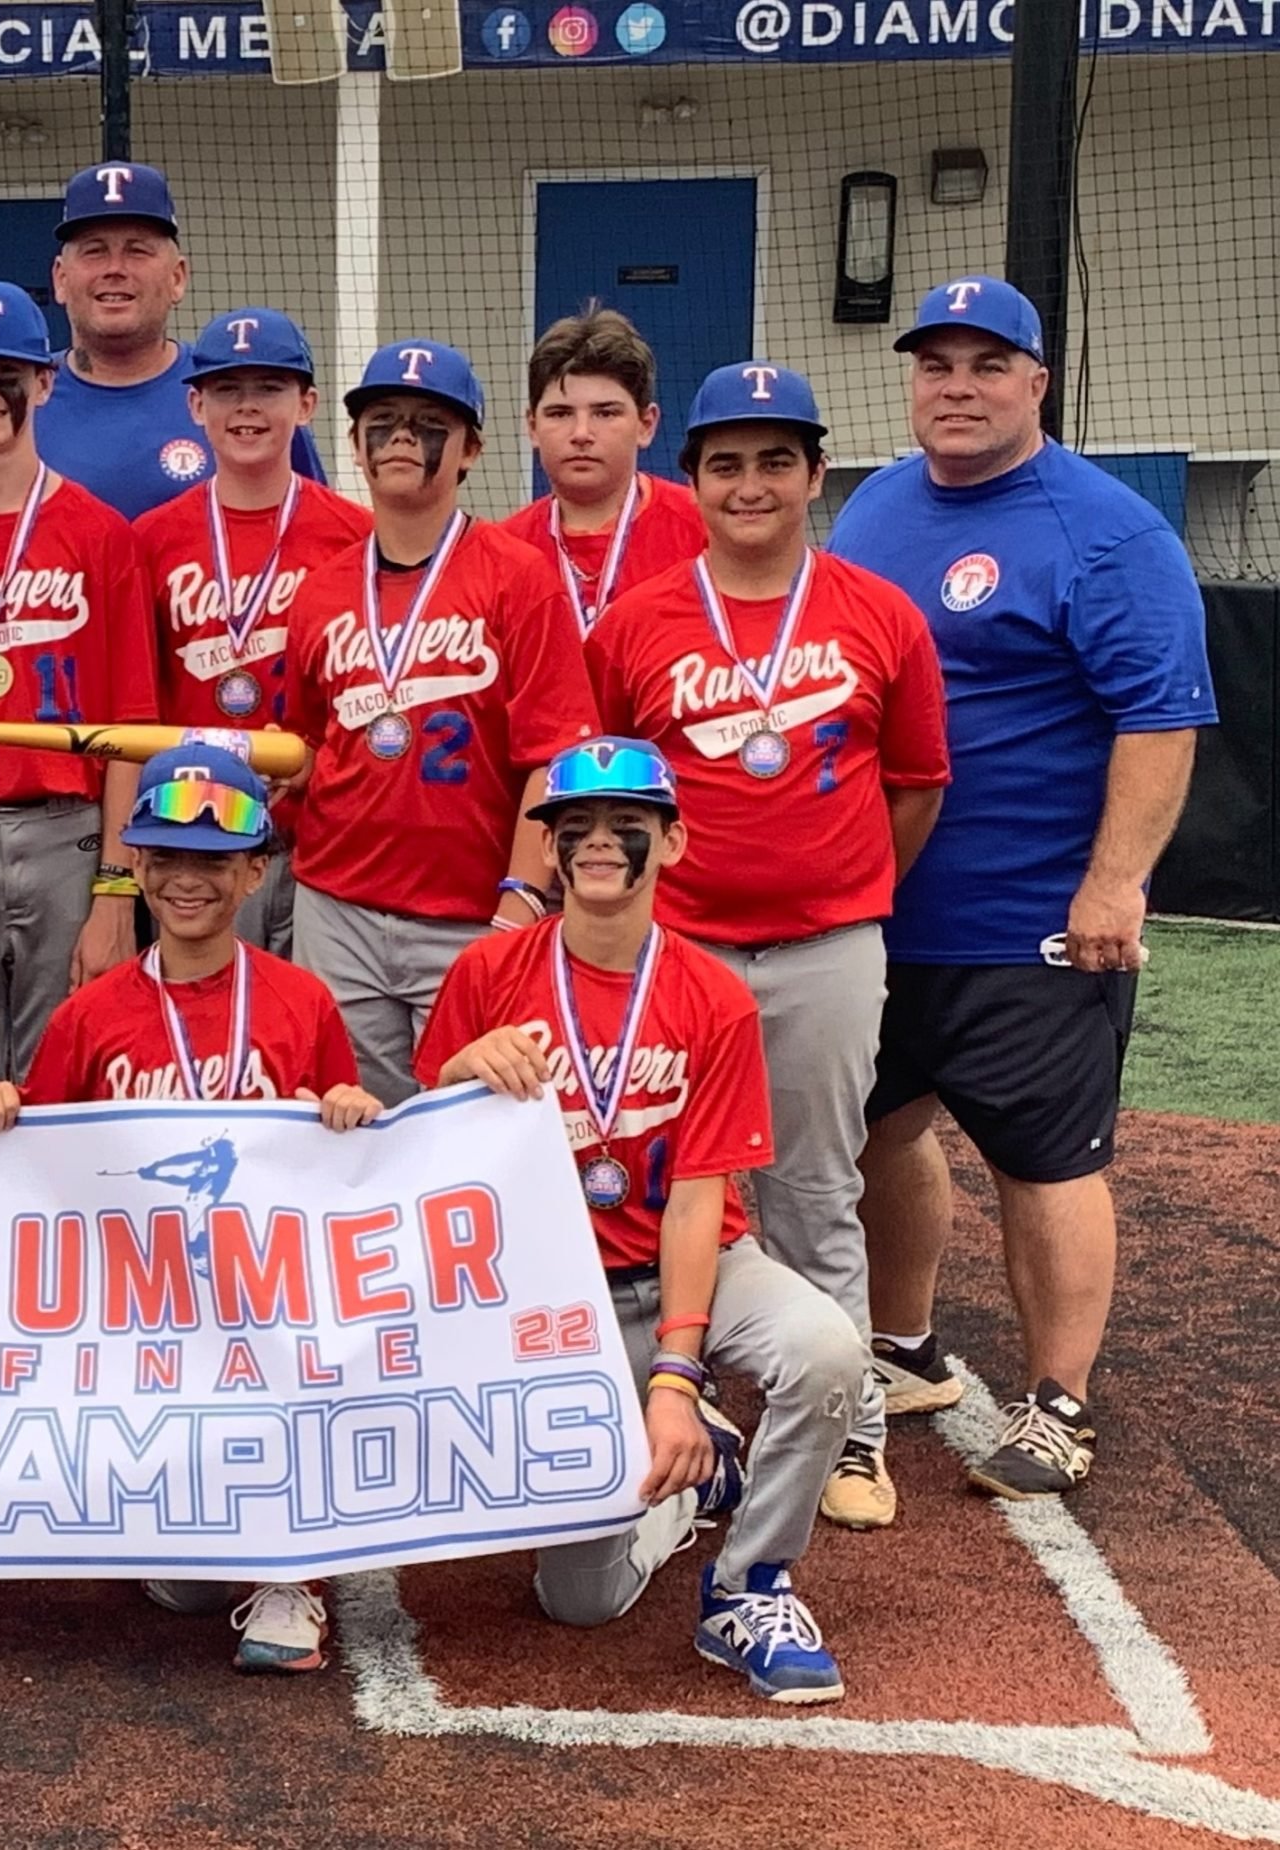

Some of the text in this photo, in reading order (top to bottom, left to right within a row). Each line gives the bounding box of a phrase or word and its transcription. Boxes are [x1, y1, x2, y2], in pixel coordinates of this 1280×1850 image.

[96, 168, 132, 202] T
[947, 282, 980, 311] T
[227, 319, 259, 351] T
[399, 349, 433, 381] T
[743, 367, 778, 399] T
[35, 654, 83, 722] 11
[421, 710, 472, 783] 2
[814, 721, 848, 794] 7
[0, 1325, 423, 1395] FINALE
[509, 1301, 601, 1363] 22
